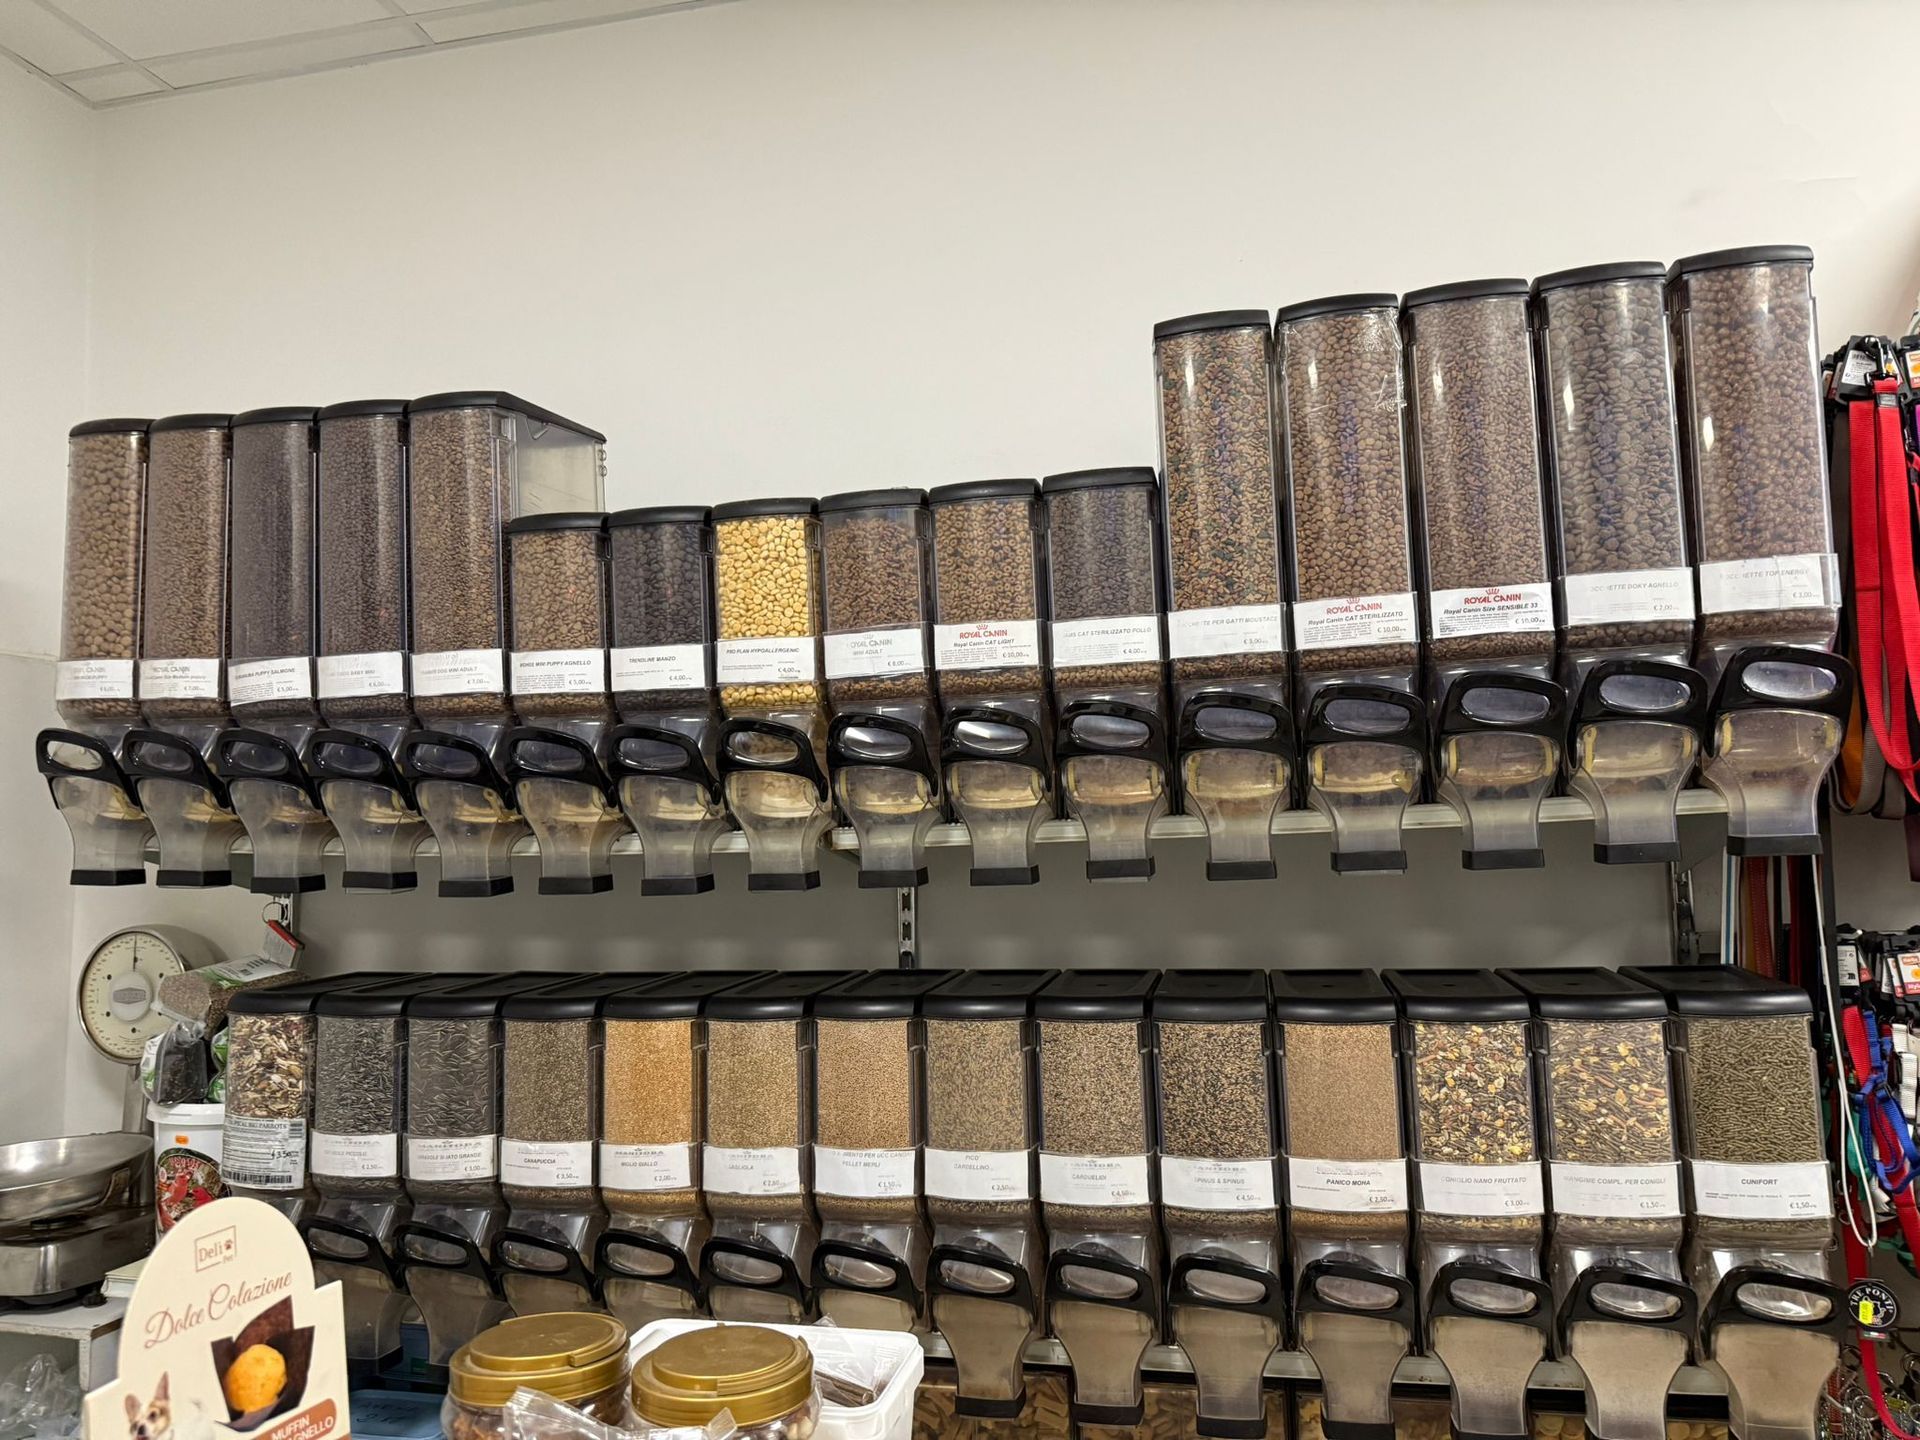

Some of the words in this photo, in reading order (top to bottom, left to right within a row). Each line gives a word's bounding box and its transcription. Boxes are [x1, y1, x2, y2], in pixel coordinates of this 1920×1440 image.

[1464, 595, 1492, 605] ROYAL
[1493, 593, 1522, 602] CANIN
[1326, 604, 1354, 615] ROYAL
[1355, 602, 1383, 612] CANIN
[1444, 607, 1462, 616] Royal
[1463, 606, 1481, 614] Canin
[1497, 603, 1529, 611] SENSIBLE
[1308, 618, 1325, 627] Royal
[1359, 611, 1403, 620] STERILIZZATO
[959, 631, 982, 640] ROYAL
[983, 630, 1008, 638] CANIN
[1090, 628, 1131, 636] STERILIZZATO
[953, 641, 968, 649] Royal
[1326, 1178, 1351, 1186] PANICO
[1741, 1178, 1778, 1186] CUNIFORT
[199, 1241, 224, 1263] Deli
[144, 1303, 204, 1350] Dolce
[209, 1271, 293, 1321] Colazione
[271, 1414, 310, 1440] MUFFIN
